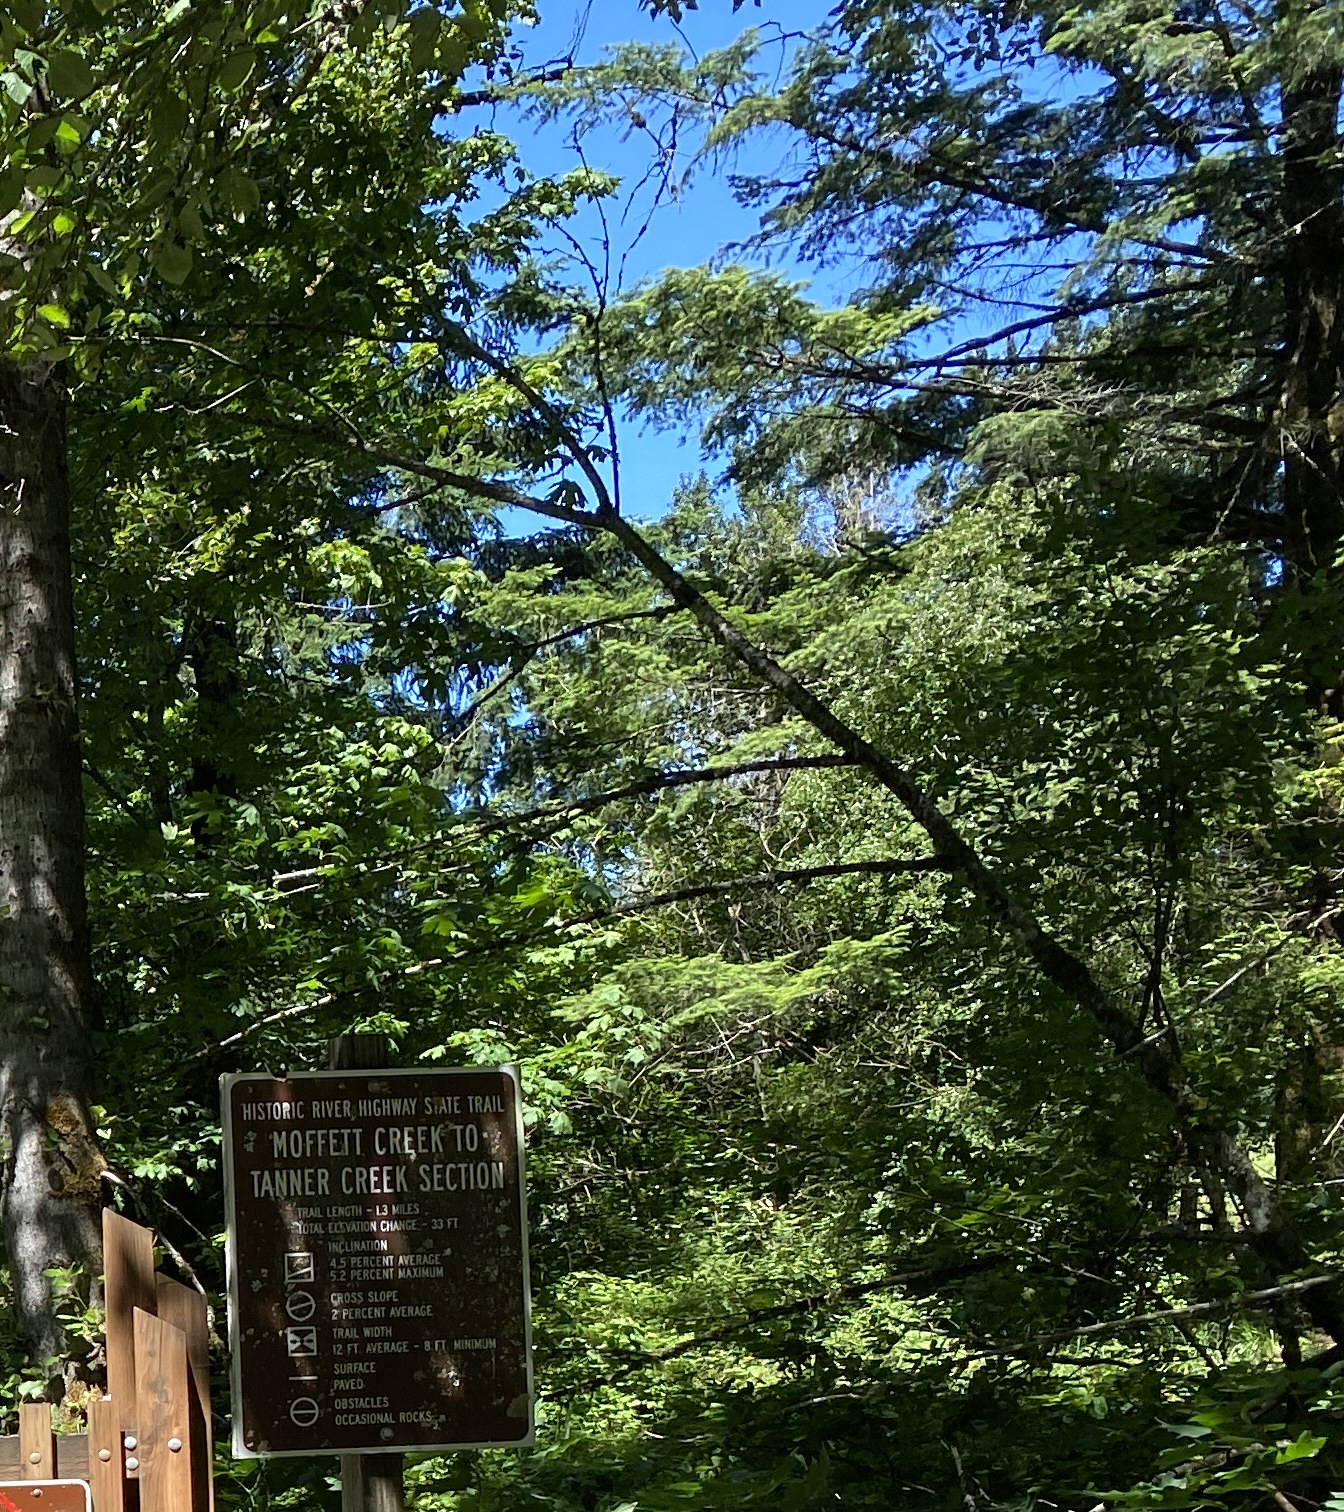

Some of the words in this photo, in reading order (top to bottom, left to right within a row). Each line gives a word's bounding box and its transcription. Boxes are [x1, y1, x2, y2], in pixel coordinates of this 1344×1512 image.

[241, 1100, 304, 1121] HISTORIC
[312, 1098, 351, 1119] RIVER
[359, 1097, 417, 1118] HIGHWAY
[424, 1095, 461, 1115] STATE
[467, 1094, 505, 1114] TRAIL
[272, 1127, 363, 1158] MOFFETT
[374, 1124, 444, 1156] CREEK
[453, 1123, 479, 1152] TO
[250, 1168, 330, 1198] TANNER
[341, 1165, 408, 1195] CREEK
[419, 1161, 505, 1192] SECTION
[297, 1206, 323, 1219] TRAIL
[326, 1205, 362, 1218] LENGTH
[392, 1203, 420, 1215] MILES
[297, 1222, 325, 1235] TOTAL
[328, 1220, 377, 1234] ELEVATION
[380, 1219, 418, 1232] CHANGE
[431, 1218, 443, 1230] 33
[446, 1217, 459, 1229] FT
[328, 1239, 388, 1253] INCLINATION
[330, 1257, 347, 1270] 4.5
[350, 1255, 394, 1269] PERCENT
[398, 1253, 441, 1267] AVERAGE
[330, 1270, 346, 1282] 5.2
[350, 1268, 394, 1281] PERCENT
[398, 1267, 444, 1279] MAXIMUM
[330, 1291, 362, 1305] CROSS
[368, 1290, 399, 1303] SLOPE
[331, 1309, 339, 1321] 2
[342, 1306, 386, 1320] PERCENT
[389, 1304, 433, 1318] AVERAGE
[332, 1327, 359, 1340] TRAIL
[363, 1325, 393, 1339] WIDTH
[333, 1343, 343, 1356] 12
[366, 1340, 410, 1354] AVERAGE
[423, 1339, 431, 1352] 8
[453, 1337, 497, 1350] MINIMUM
[333, 1361, 377, 1375] SURFACE
[333, 1378, 364, 1391] PAVED
[334, 1396, 390, 1410] OBSTACLES
[335, 1412, 396, 1426] OCCASIONAL
[399, 1410, 432, 1424] ROCKS
